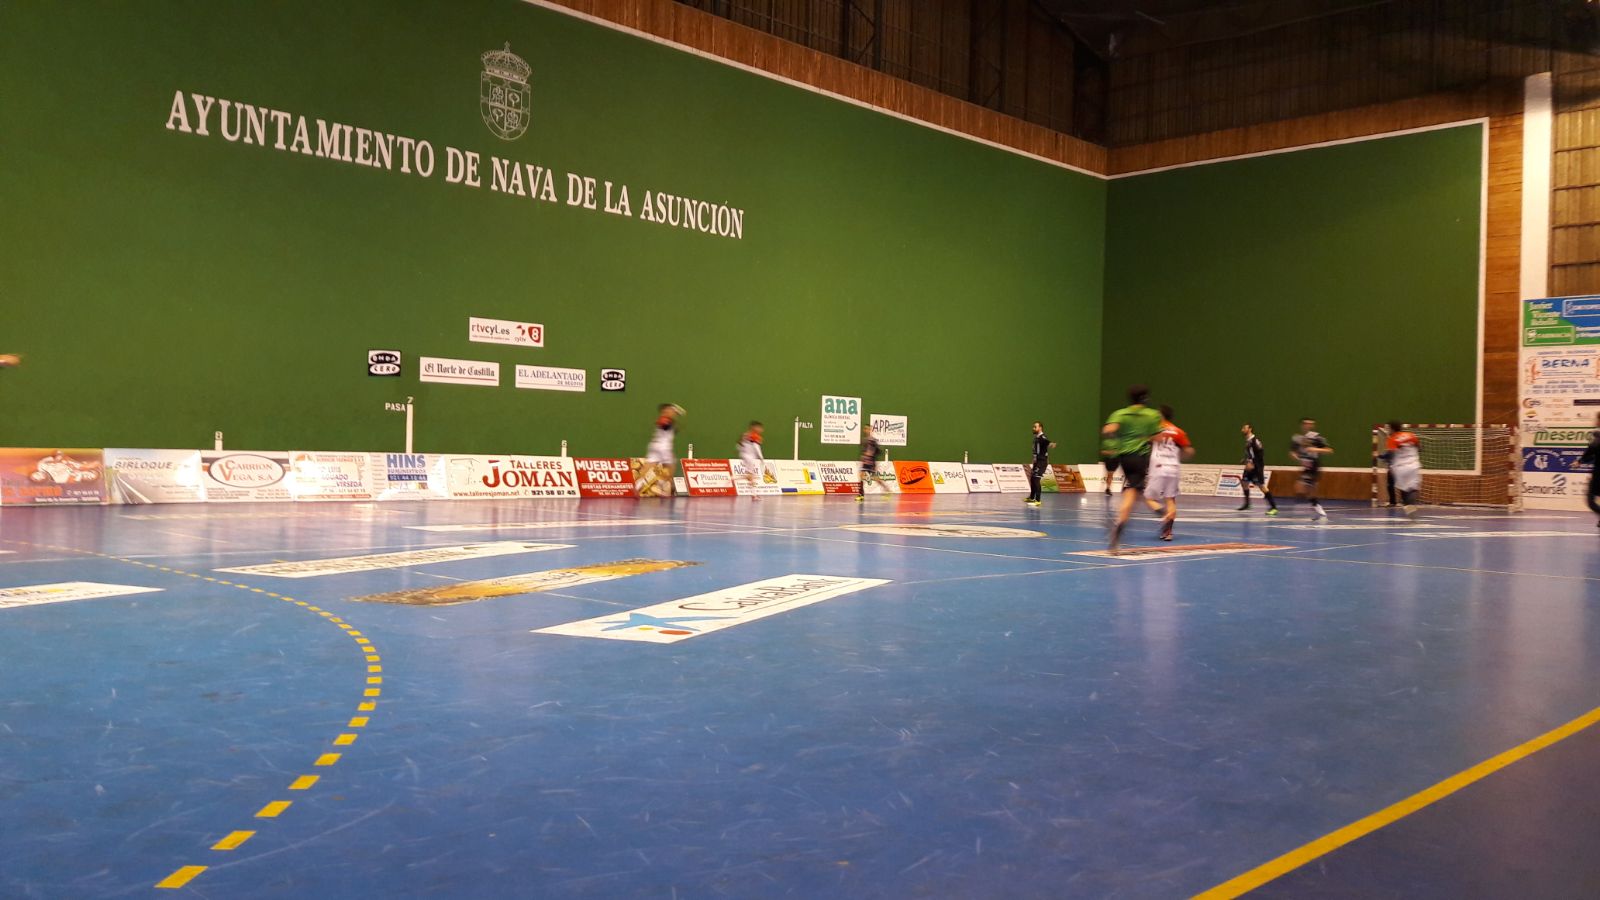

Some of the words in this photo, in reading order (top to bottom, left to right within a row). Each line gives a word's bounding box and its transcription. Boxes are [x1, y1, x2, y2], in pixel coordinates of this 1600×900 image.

[165, 90, 435, 178] AYUNTAMIENTO
[446, 147, 481, 188] DE
[491, 157, 558, 203] NAVA
[567, 172, 597, 210] DE
[604, 182, 633, 217] LA
[640, 190, 744, 240] ASUNCIÓN
[471, 323, 510, 336] rtvcyl.es
[531, 328, 539, 340] 8
[372, 354, 398, 363] ONDA
[373, 365, 397, 374] CERO
[424, 363, 434, 374] El
[437, 364, 456, 375] Norte
[459, 366, 467, 375] de
[468, 366, 495, 377] Castilla
[603, 371, 624, 379] ONDA
[518, 370, 529, 378] EL
[531, 370, 584, 382] ADELANTADO
[605, 382, 623, 390] CERO
[385, 402, 406, 412] PASA
[825, 398, 858, 415] ana
[799, 421, 813, 429] FALTA
[872, 419, 890, 433] APP
[114, 461, 172, 470] BIRLOQUE
[386, 454, 426, 468] HINS
[510, 460, 562, 469] TALLERES
[575, 460, 629, 471] MUEBLES
[482, 460, 573, 488] JOMAN
[588, 471, 622, 482] POLO
